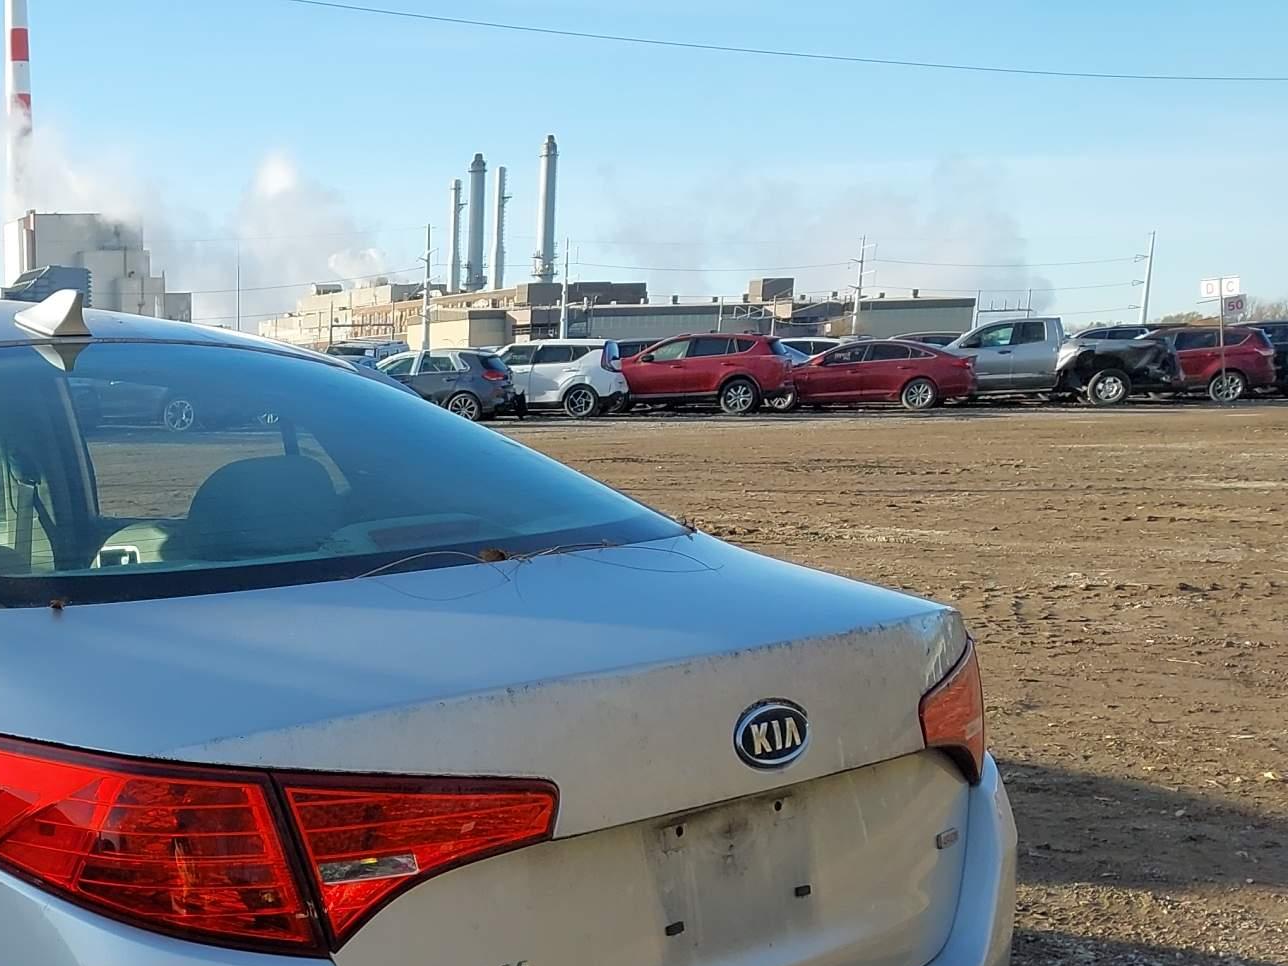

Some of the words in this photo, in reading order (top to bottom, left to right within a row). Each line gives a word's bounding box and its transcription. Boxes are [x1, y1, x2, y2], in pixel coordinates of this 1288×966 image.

[1226, 280, 1235, 293] C
[1227, 300, 1244, 312] 50
[750, 716, 802, 756] KIA
